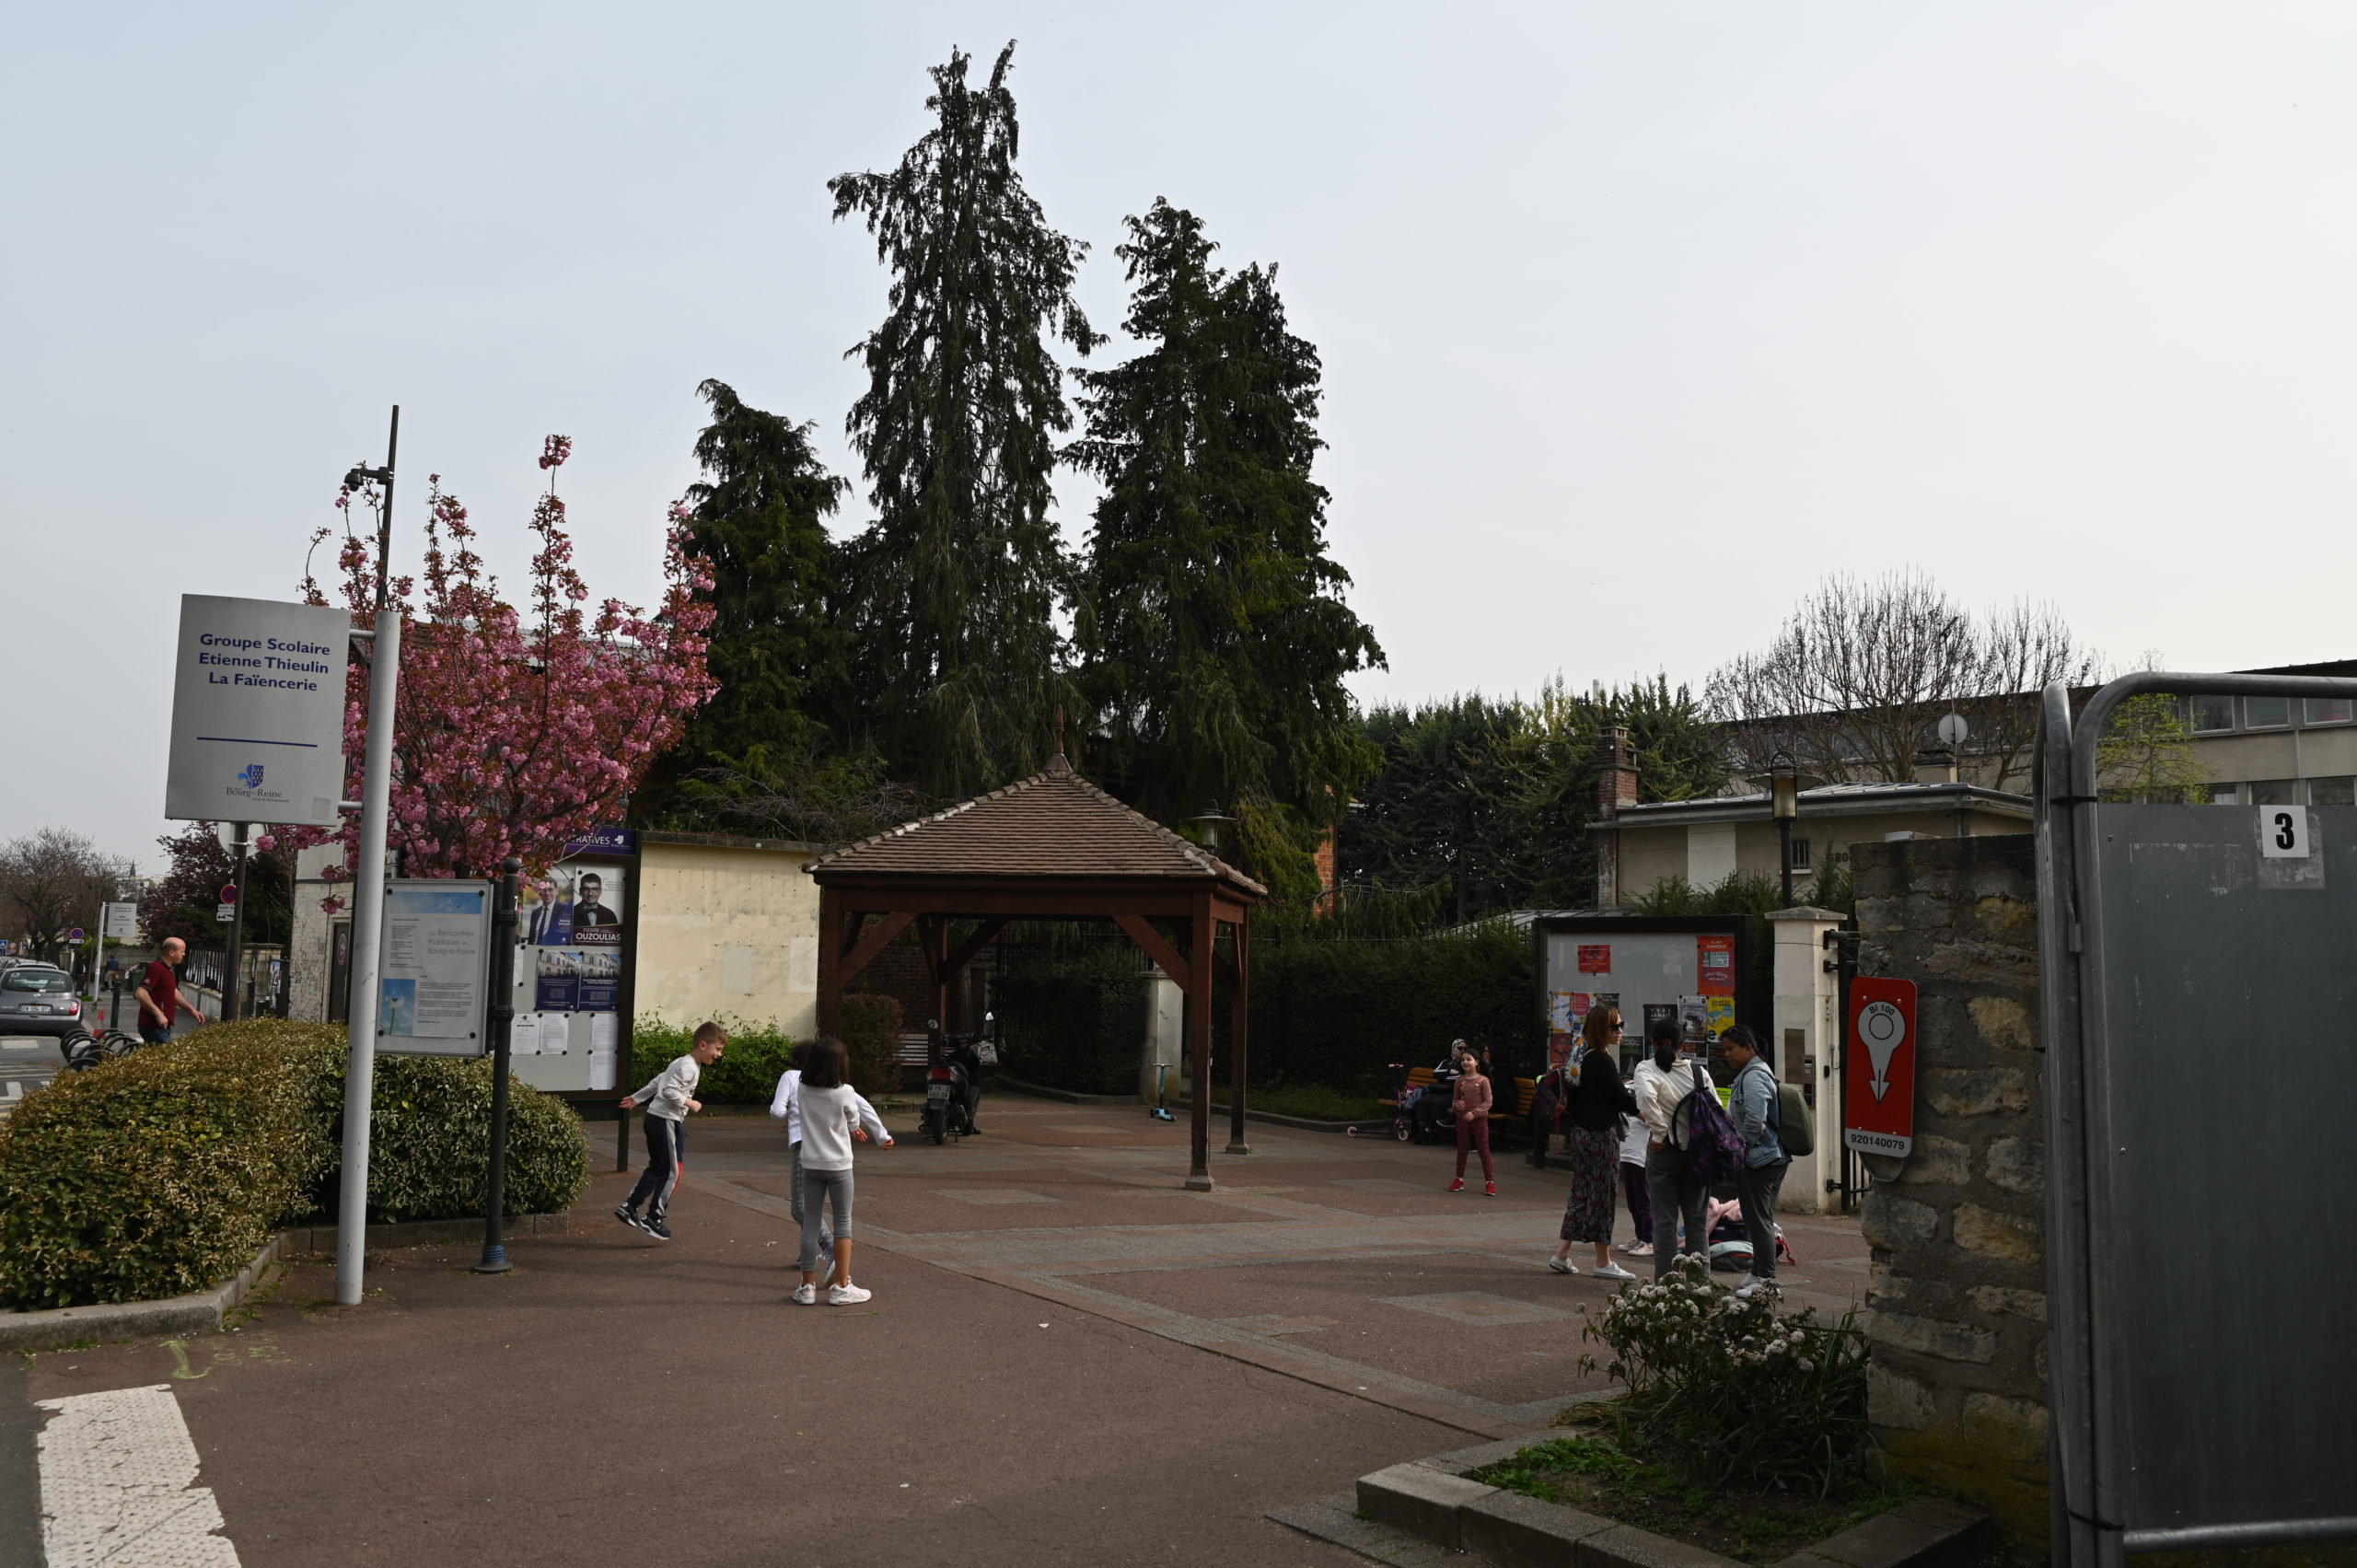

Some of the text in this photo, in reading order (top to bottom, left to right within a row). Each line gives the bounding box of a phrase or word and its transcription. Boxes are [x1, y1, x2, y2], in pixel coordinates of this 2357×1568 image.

[200, 633, 331, 655] Groupe Scolaire
[199, 652, 329, 674] Etienne Thieulin
[209, 672, 318, 691] La Faïencerie
[2274, 813, 2294, 850] 3
[437, 929, 475, 937] Rencontres
[575, 933, 621, 941] OUZOULIAS
[1881, 1005, 1895, 1016] 100
[1851, 1133, 1905, 1150] 920140079
